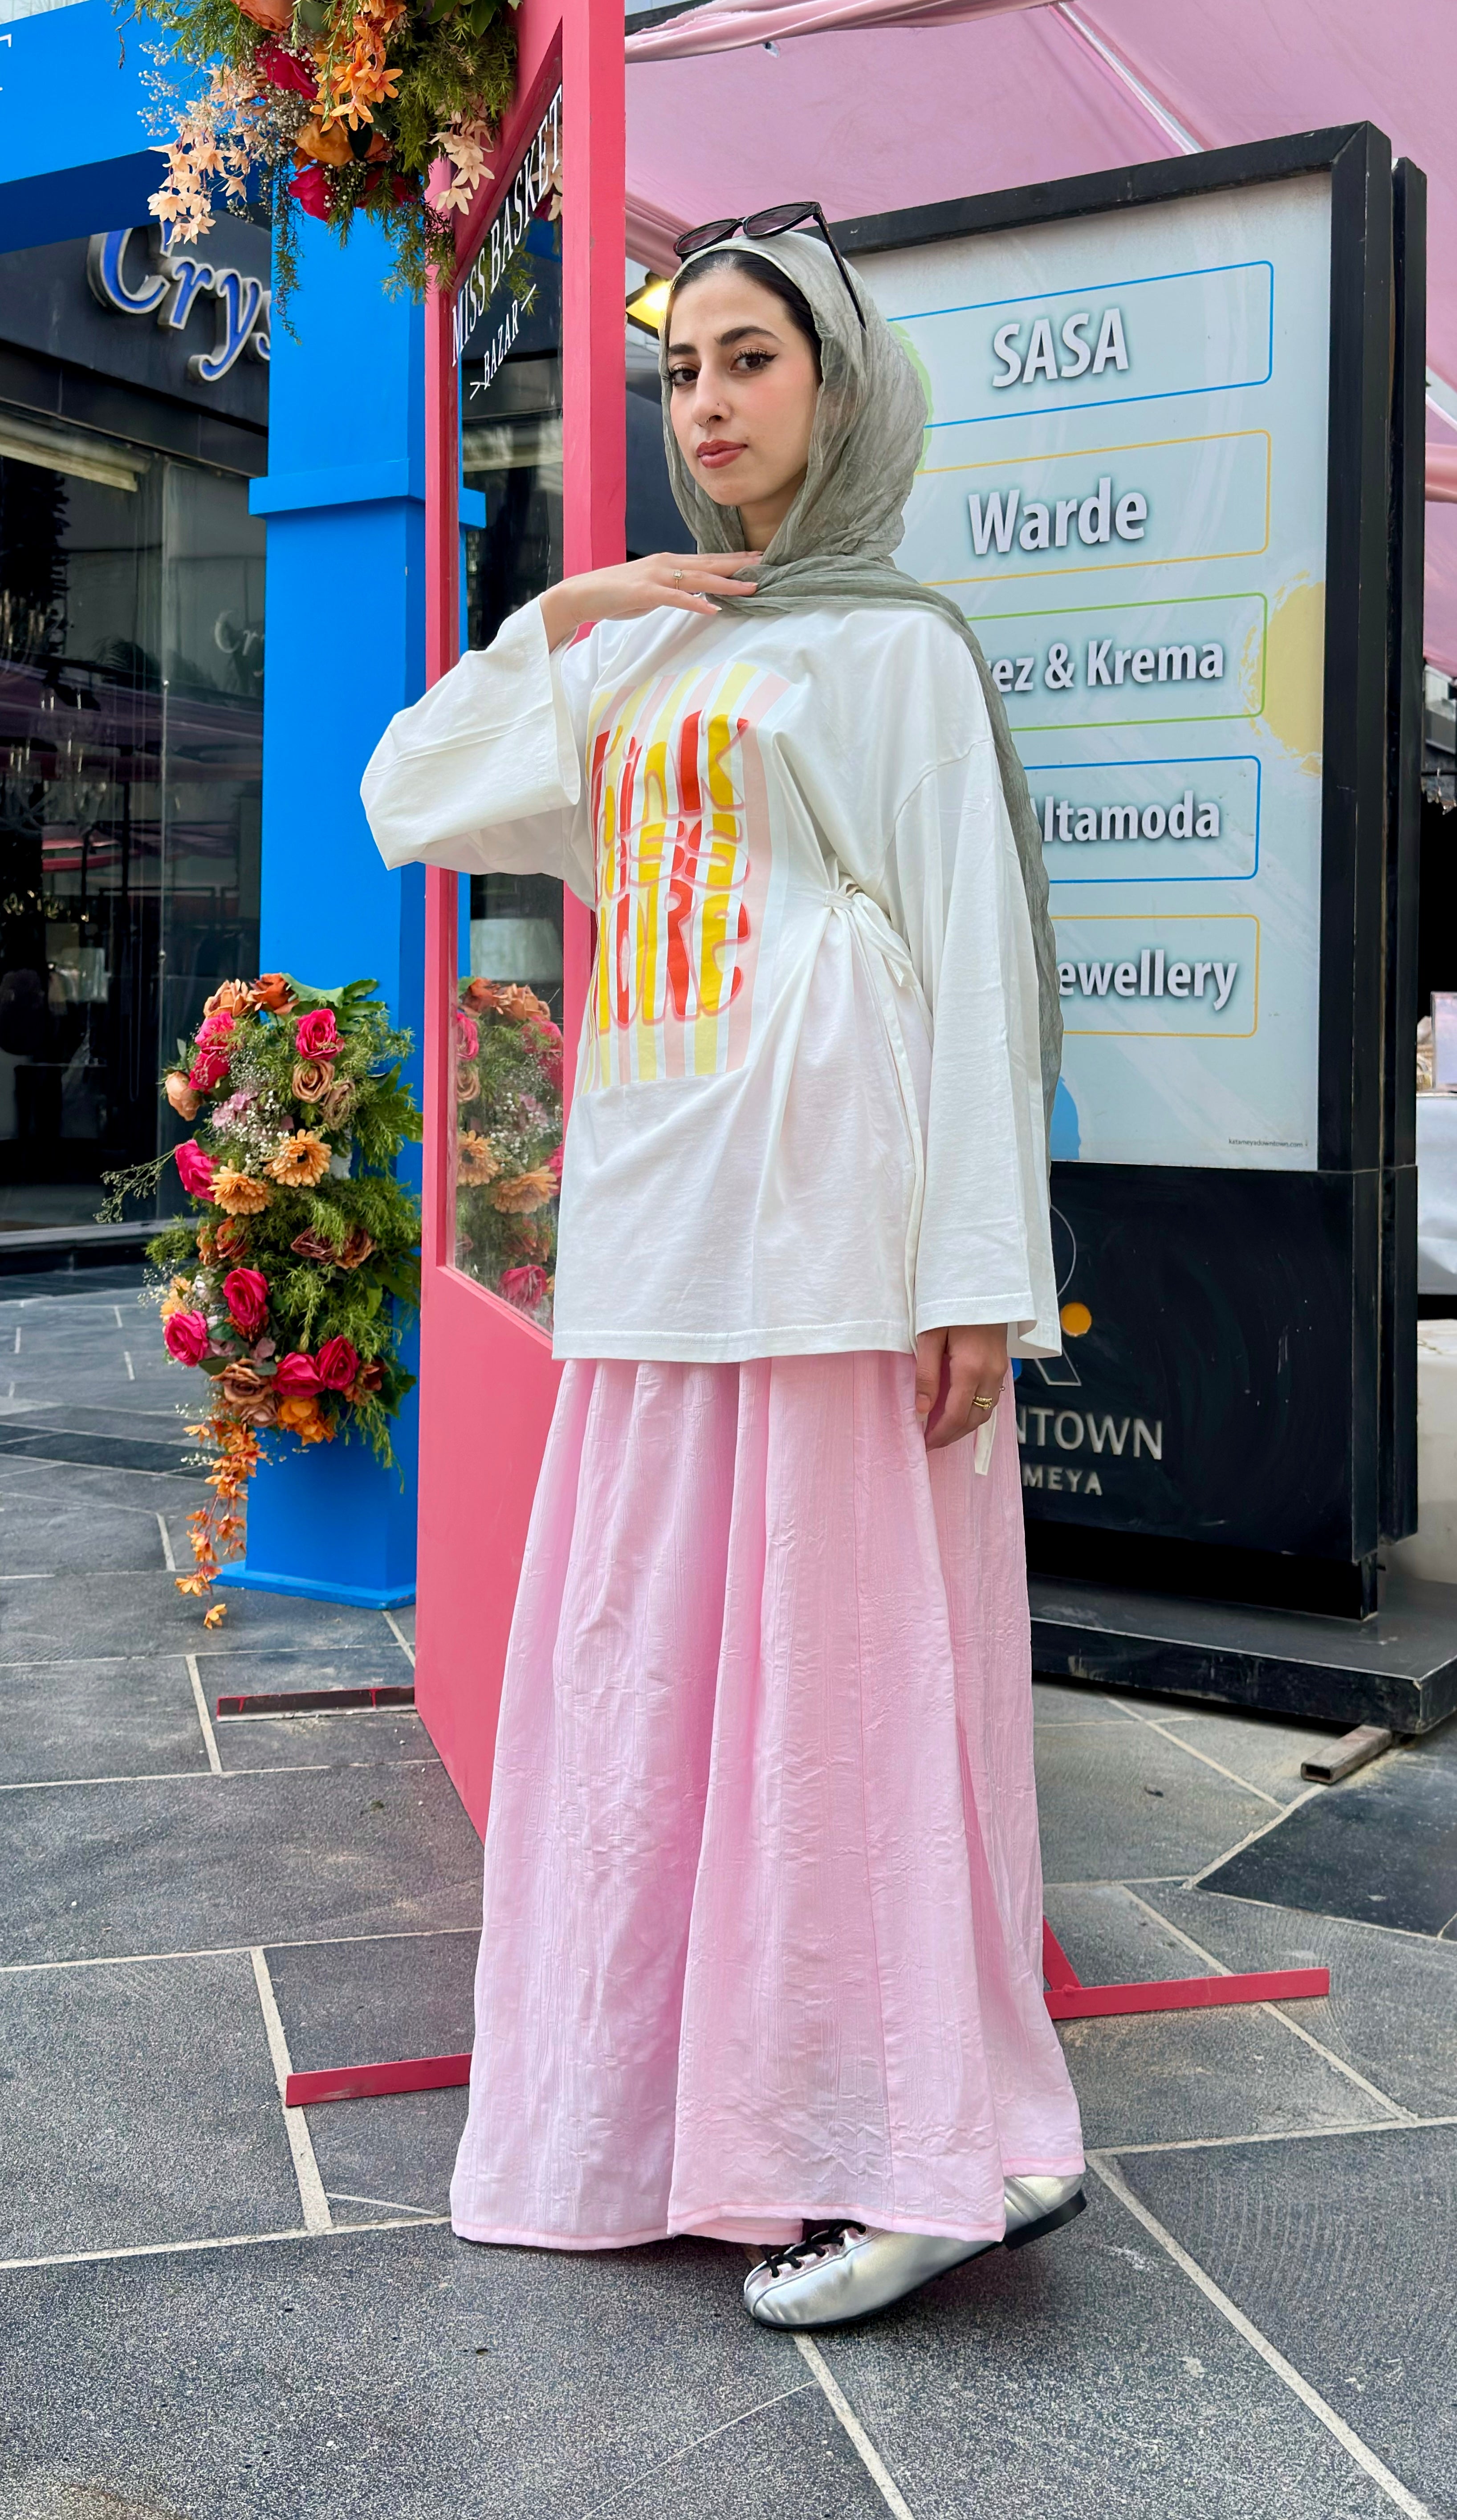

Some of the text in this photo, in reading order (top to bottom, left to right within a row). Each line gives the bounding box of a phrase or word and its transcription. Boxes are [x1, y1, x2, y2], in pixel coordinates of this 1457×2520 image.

[452, 84, 562, 367] MISS BASKET
[484, 300, 519, 390] BAZAR
[992, 308, 1129, 388] SASA
[967, 477, 1148, 555] Warde
[987, 639, 1224, 693] ez & Krema
[1030, 790, 1220, 842] ltamoda
[1022, 1463, 1103, 1496] MEYA
